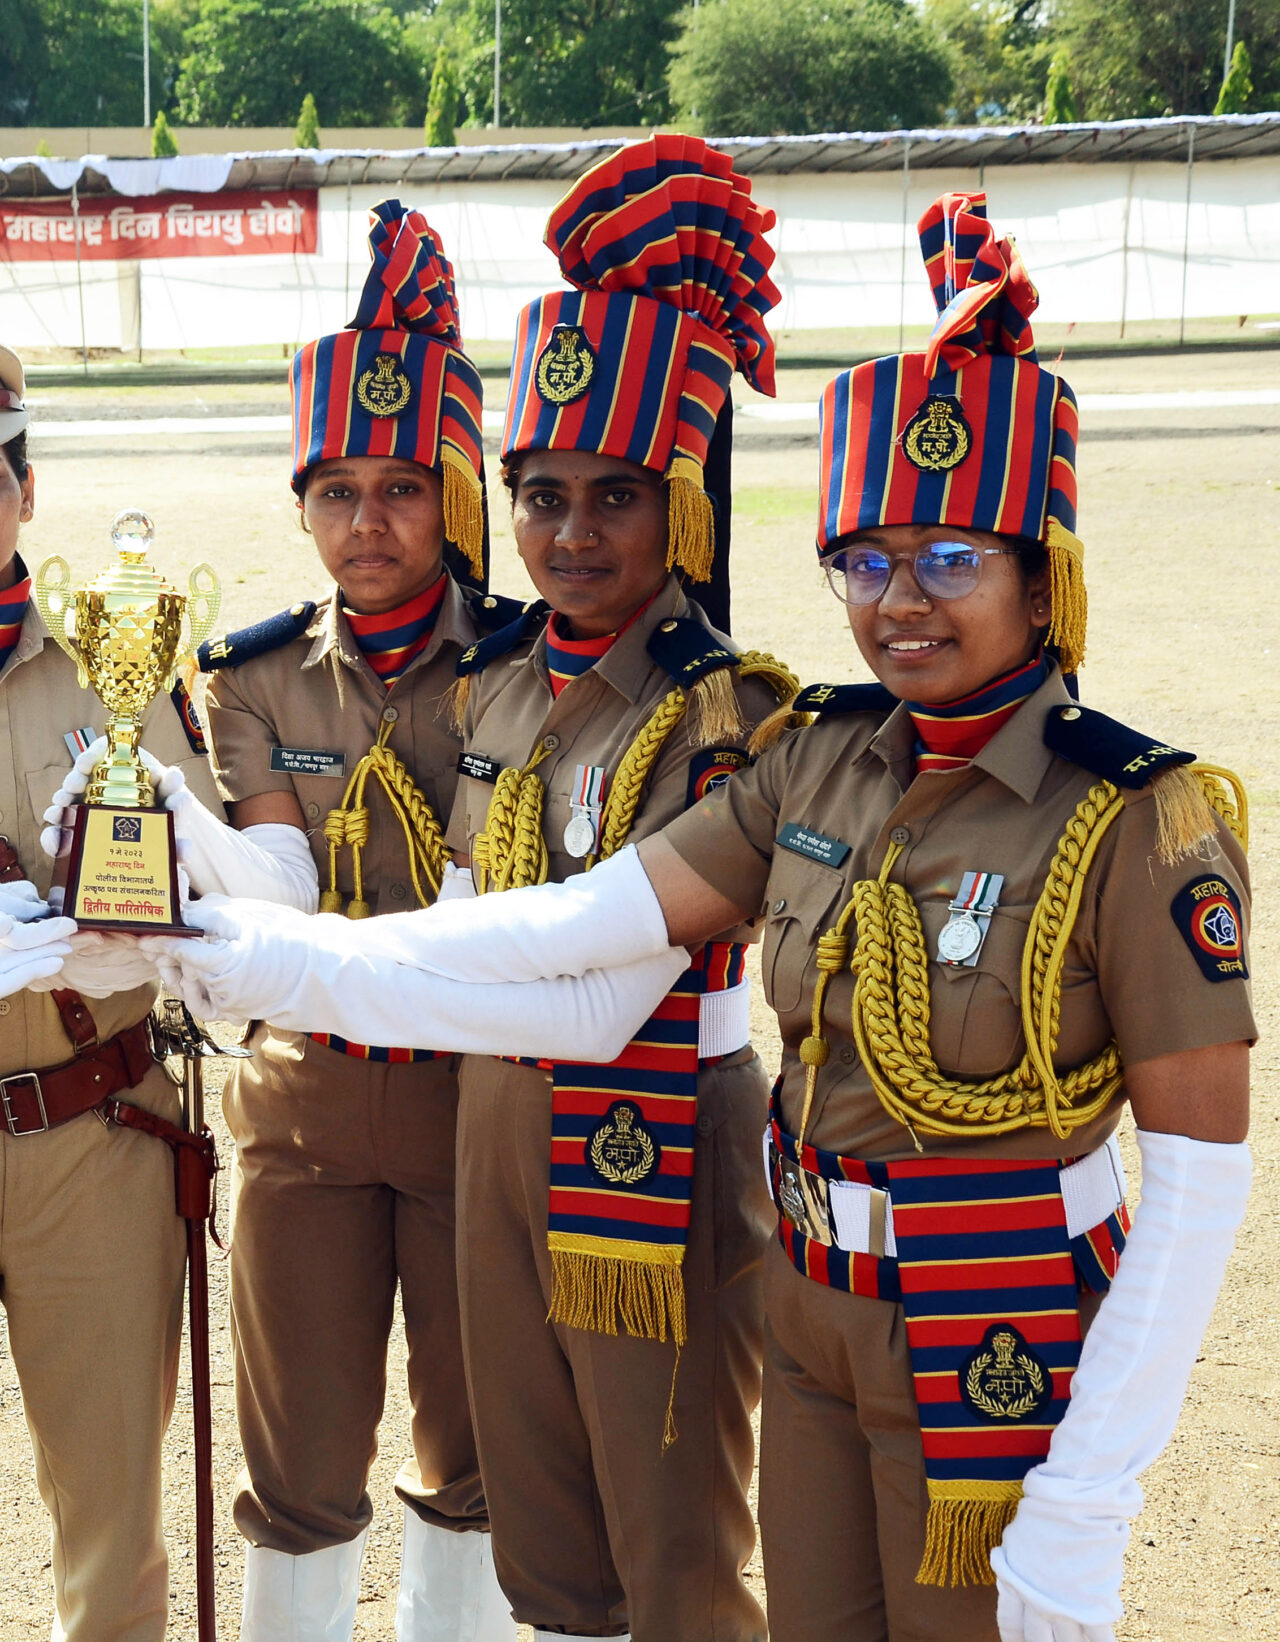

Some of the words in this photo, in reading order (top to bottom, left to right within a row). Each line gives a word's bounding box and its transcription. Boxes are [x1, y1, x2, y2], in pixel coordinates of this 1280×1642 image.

[3, 214, 105, 246] महाराष्ट्र
[108, 206, 163, 240] दिन
[165, 203, 244, 246] चिरायु
[246, 199, 305, 236] होवो
[124, 849, 143, 858] २०२३
[95, 872, 118, 882] पोलीस
[83, 896, 111, 914] द्वितीय
[114, 899, 165, 917] पारितोषिक
